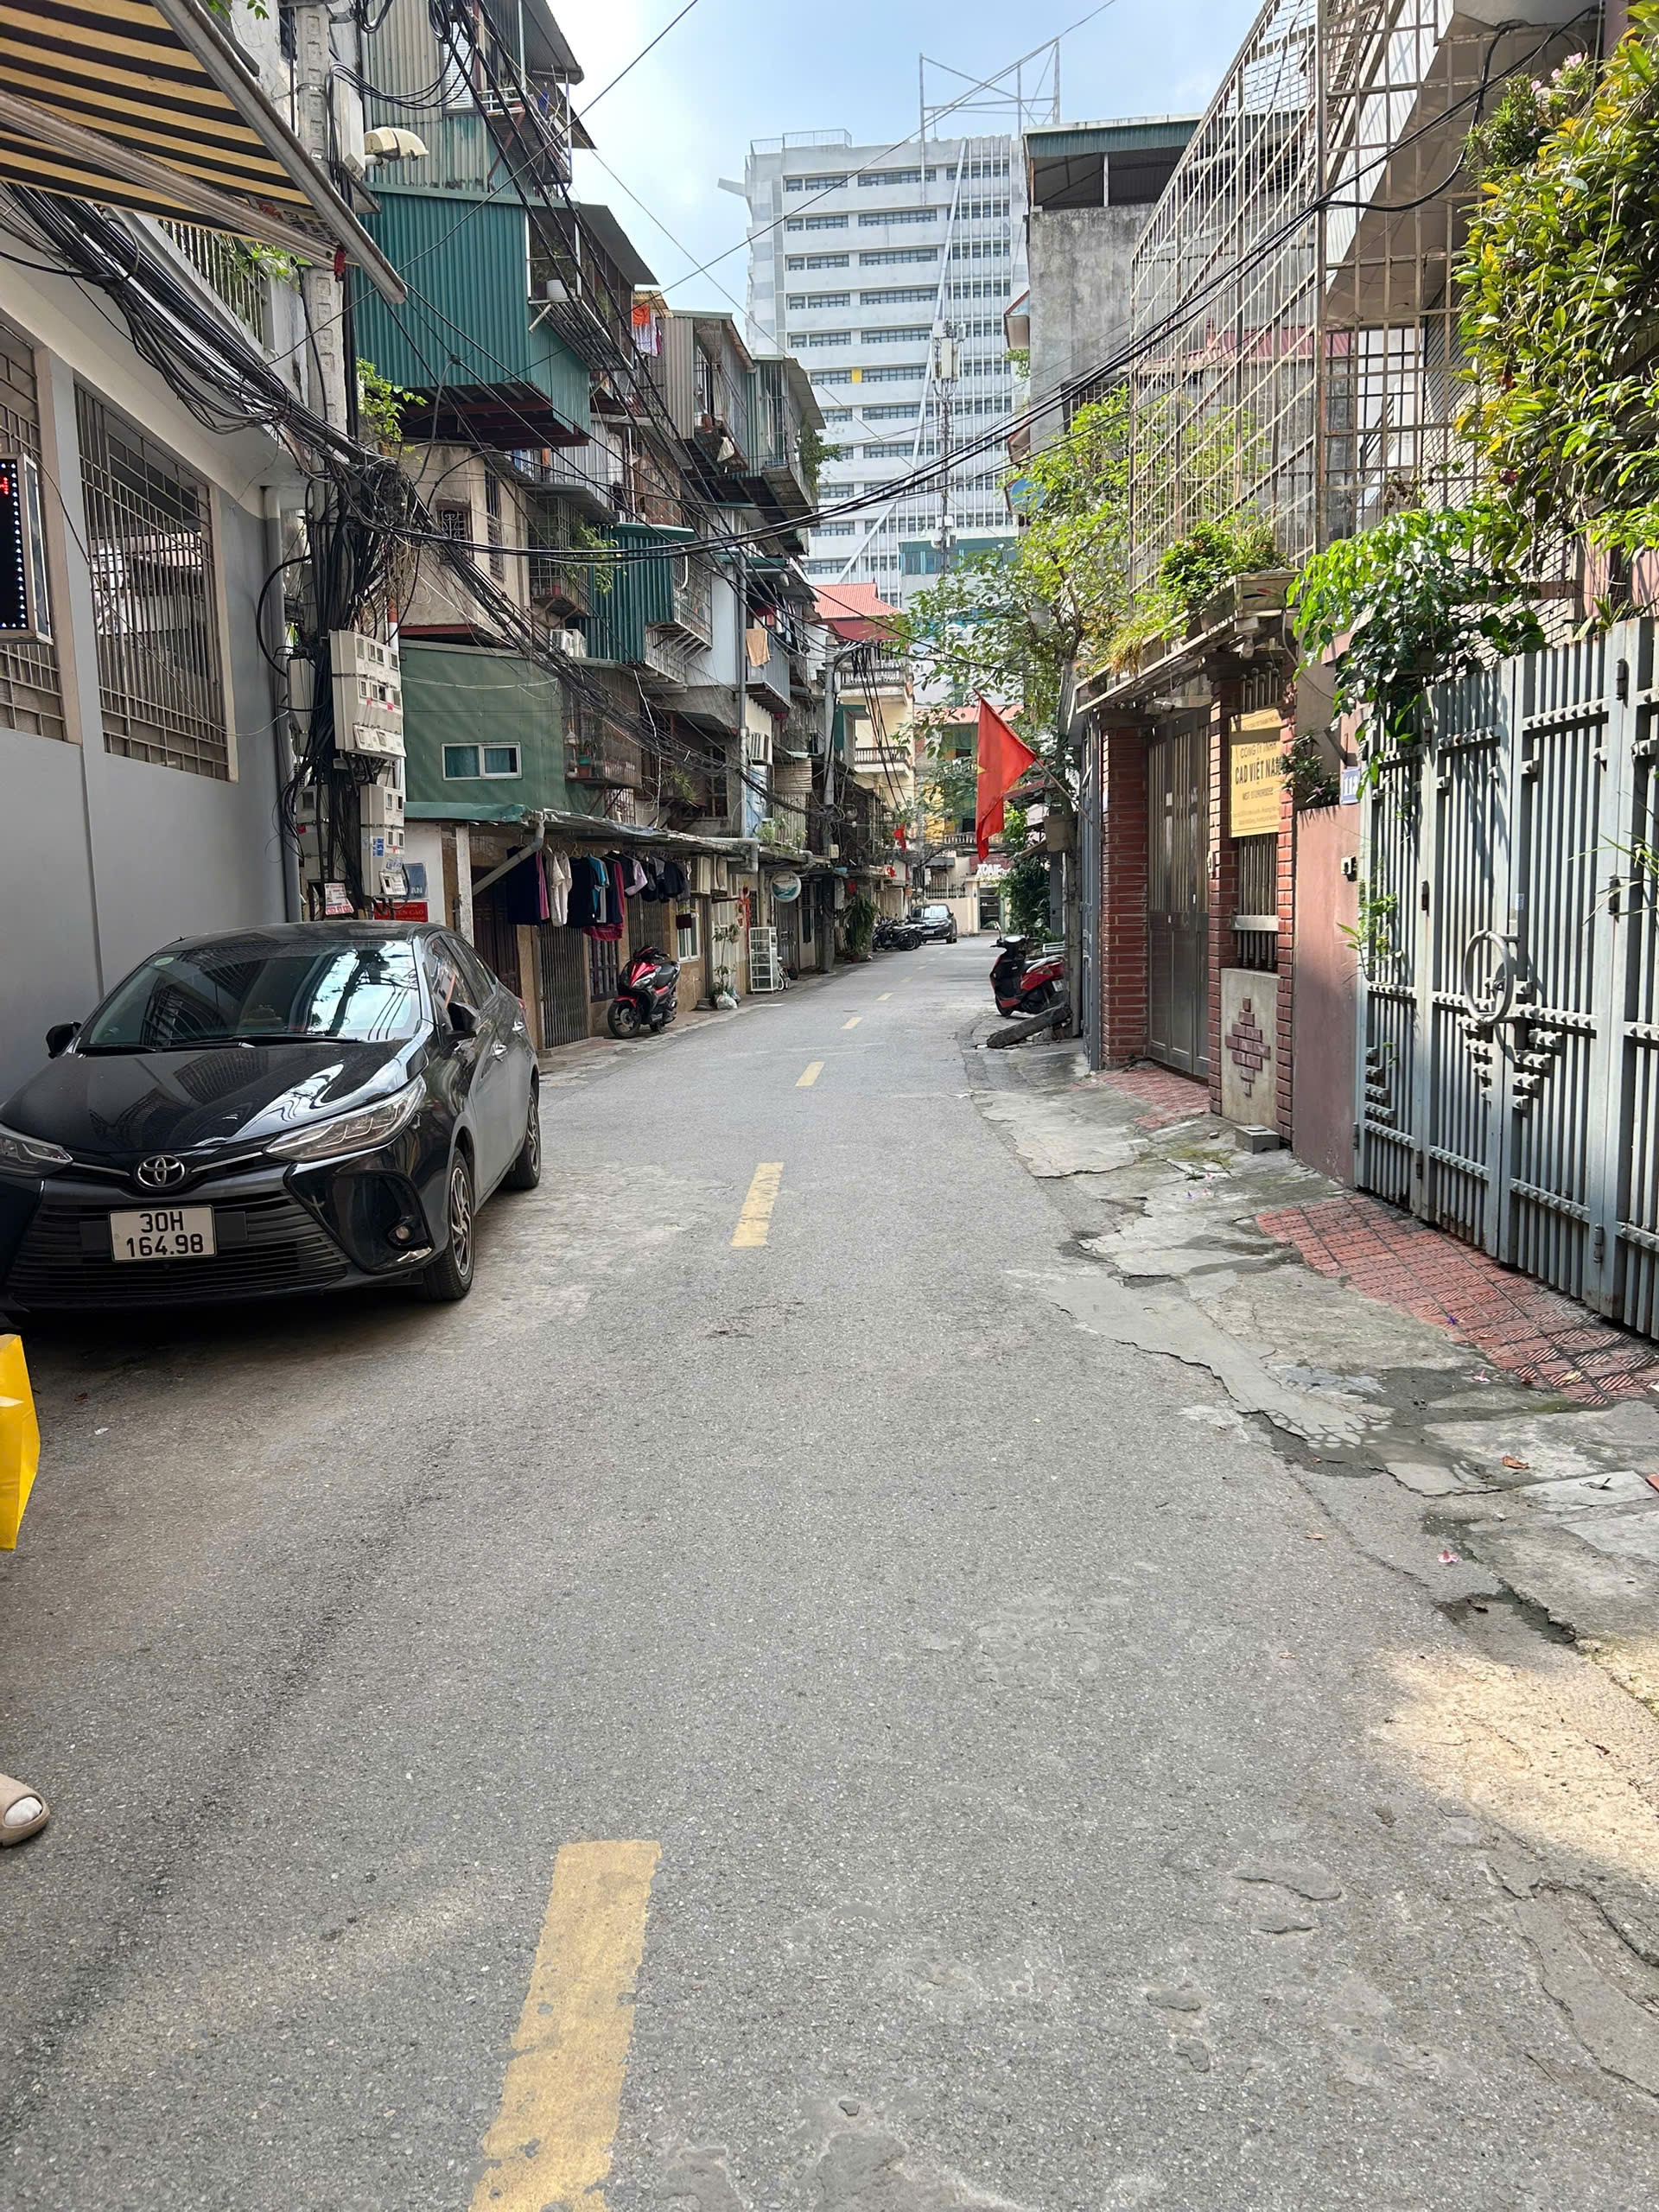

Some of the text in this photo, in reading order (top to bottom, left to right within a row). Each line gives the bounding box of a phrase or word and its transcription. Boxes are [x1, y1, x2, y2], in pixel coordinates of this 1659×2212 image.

[1235, 765, 1248, 785] CAD
[1249, 756, 1263, 785] VIỆT
[139, 1211, 184, 1233] 30H
[126, 1233, 204, 1257] 164.98
